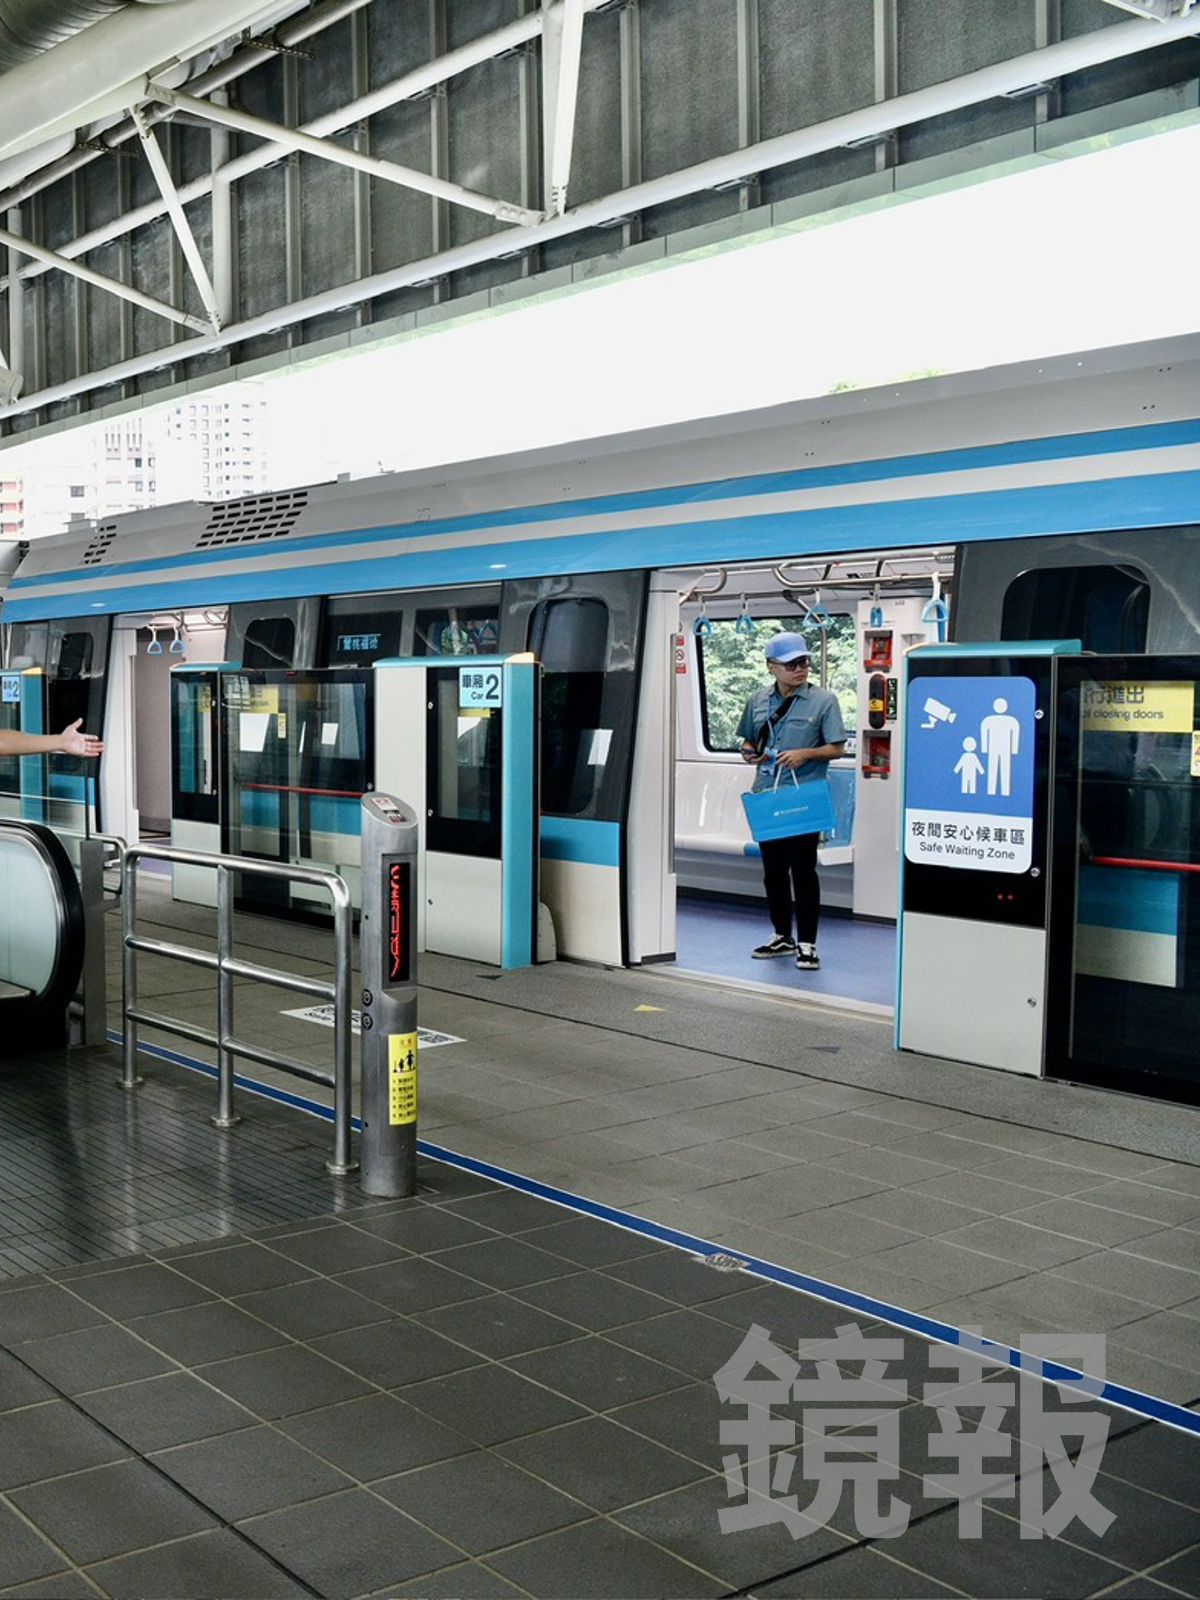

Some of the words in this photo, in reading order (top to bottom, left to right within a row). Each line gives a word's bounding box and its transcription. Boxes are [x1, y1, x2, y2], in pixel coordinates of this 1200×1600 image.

[462, 674, 484, 688] 車廂
[485, 673, 499, 700] 2
[471, 691, 483, 700] Car
[1093, 710, 1131, 721] closing
[1132, 709, 1164, 719] doors
[912, 822, 1025, 845] 夜間安心候車區
[919, 841, 944, 853] Safe
[945, 844, 985, 859] Waiting
[986, 848, 1016, 860] Zone
